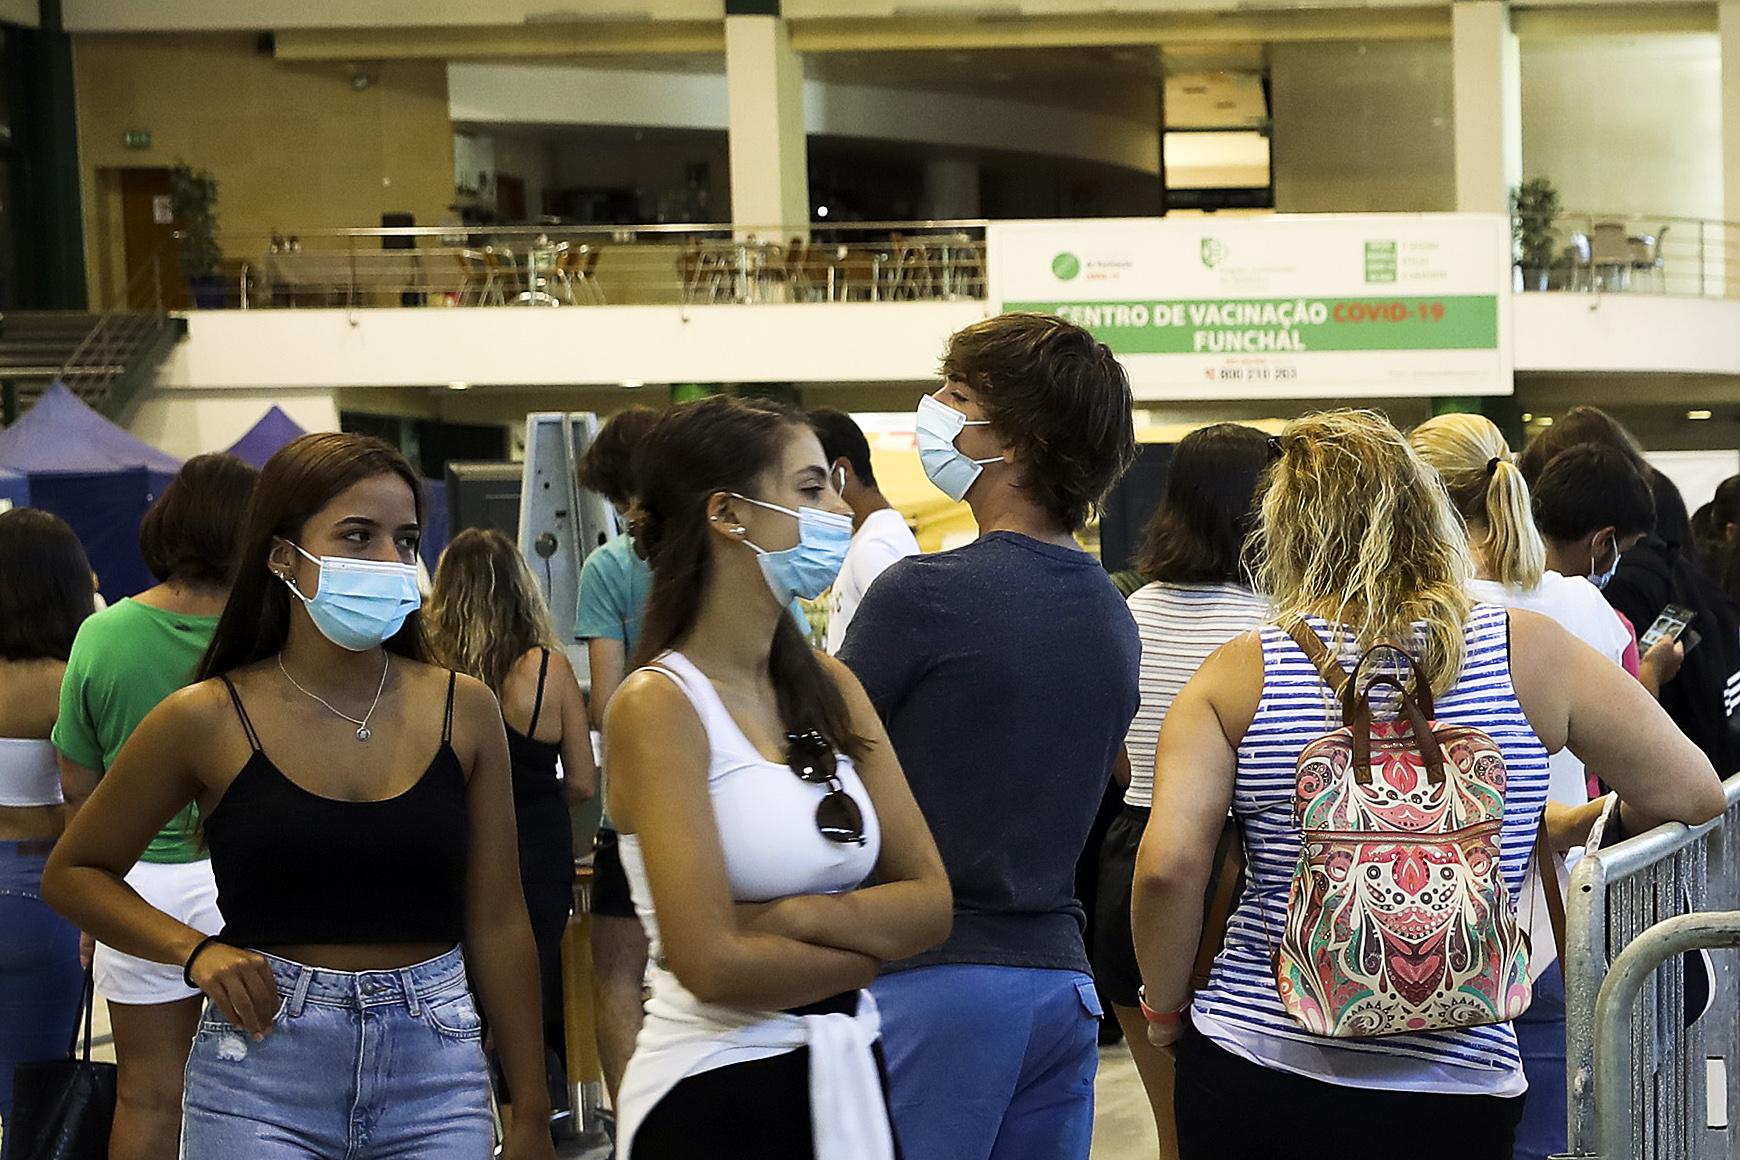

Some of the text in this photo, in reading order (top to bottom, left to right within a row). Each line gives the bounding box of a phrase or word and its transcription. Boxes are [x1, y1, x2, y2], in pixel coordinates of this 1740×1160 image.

[1154, 304, 1185, 327] DE
[1190, 299, 1327, 331] VACINAÇÃO
[1333, 303, 1445, 323] COVID-19
[1194, 330, 1306, 352] FUNCHAL
